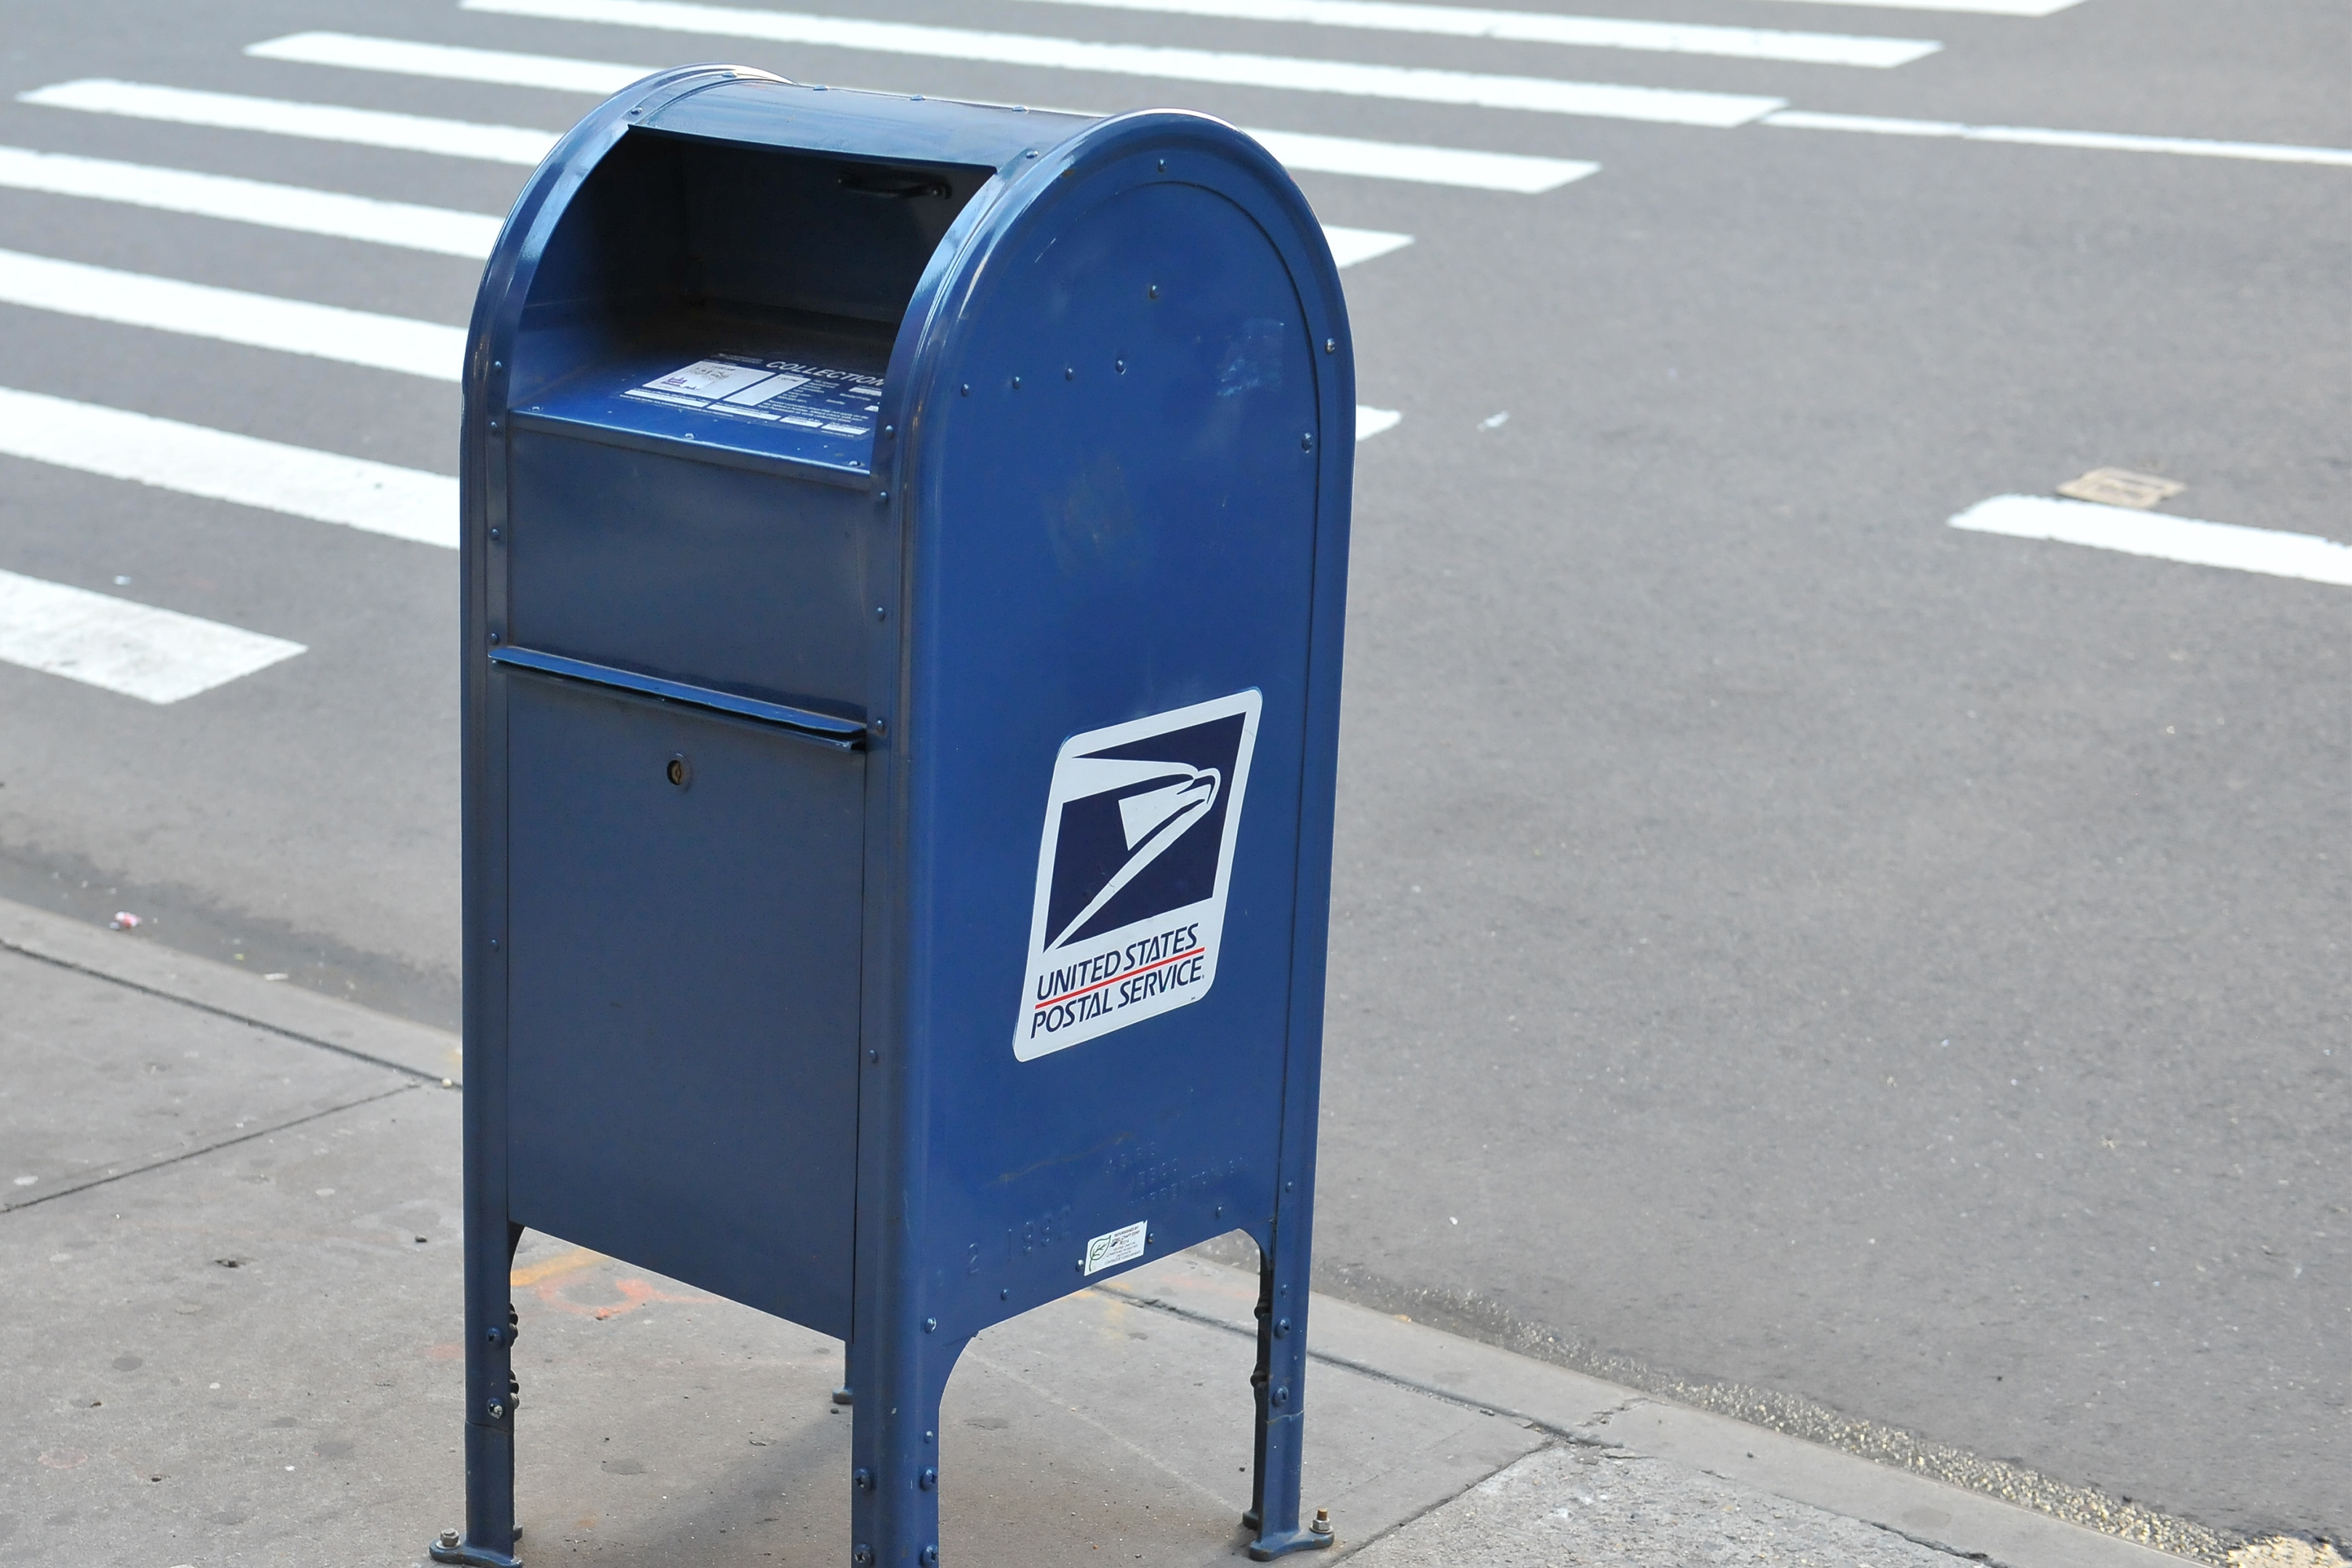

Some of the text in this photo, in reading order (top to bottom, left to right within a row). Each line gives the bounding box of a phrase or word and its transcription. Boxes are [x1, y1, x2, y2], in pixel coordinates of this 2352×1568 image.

[766, 361, 884, 386] COLLECTION
[1030, 954, 1205, 1040] POSTAL SERVICE
[1036, 922, 1200, 1001] UNITED STATES
